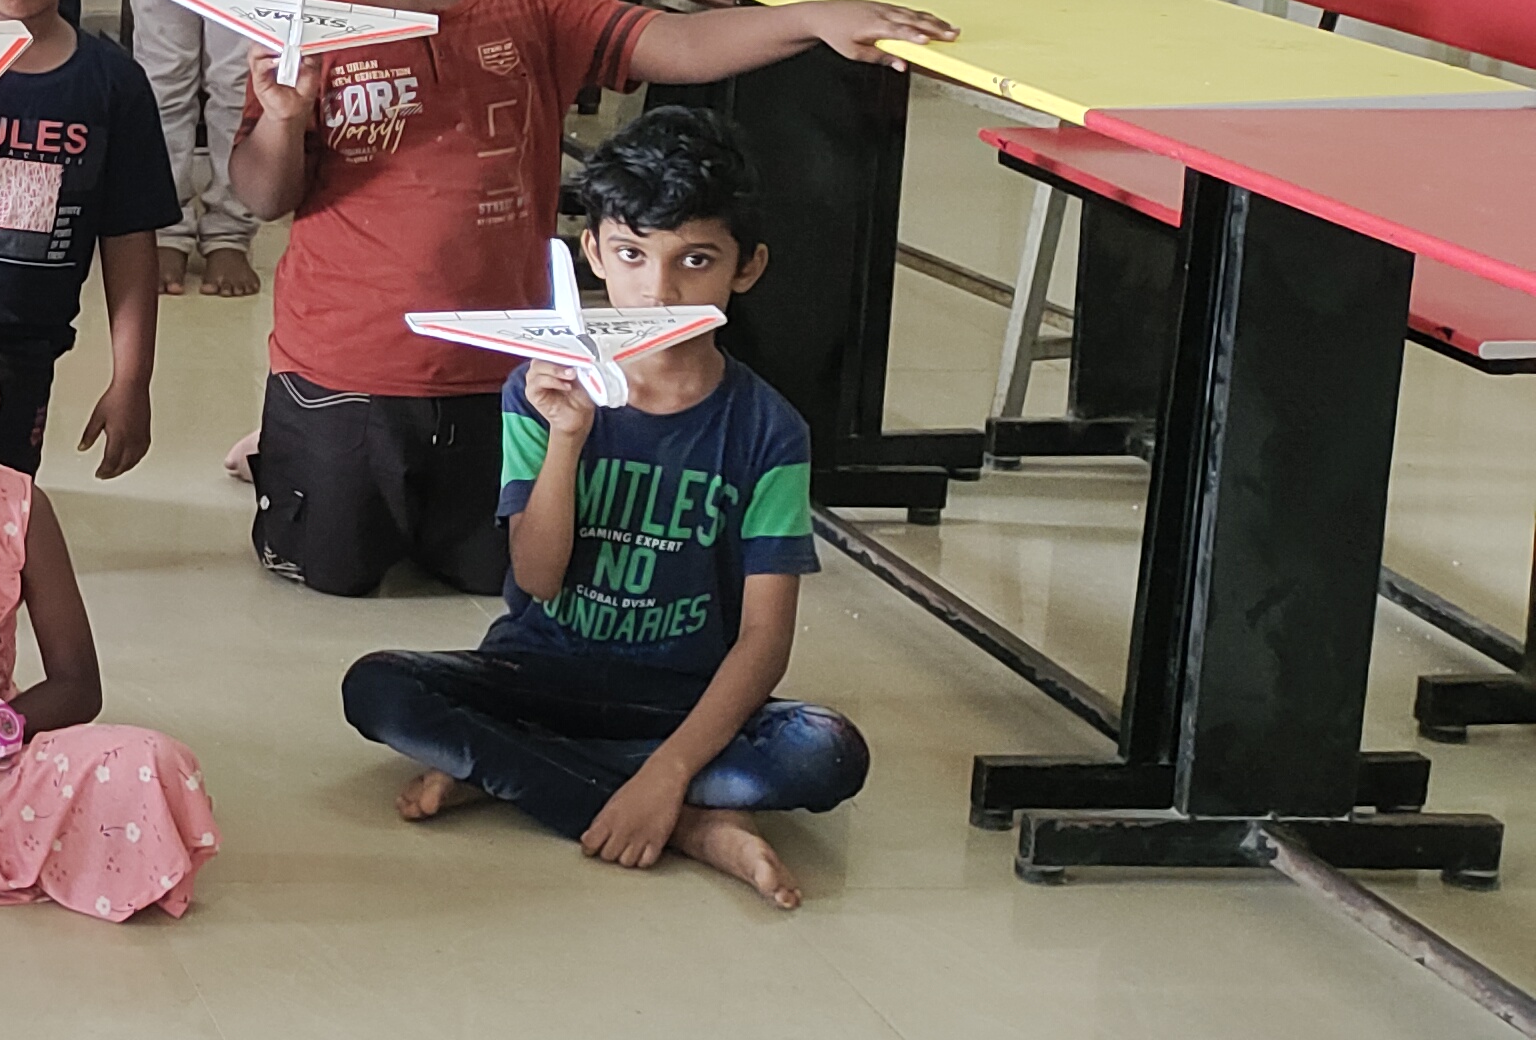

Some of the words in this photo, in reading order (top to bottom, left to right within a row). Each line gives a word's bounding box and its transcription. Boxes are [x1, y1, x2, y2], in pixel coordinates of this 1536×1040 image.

[325, 77, 418, 128] CORE
[579, 527, 632, 544] GAMING
[634, 534, 684, 552] EXPERT
[592, 541, 657, 595] NO
[576, 584, 619, 607] GLOBAL
